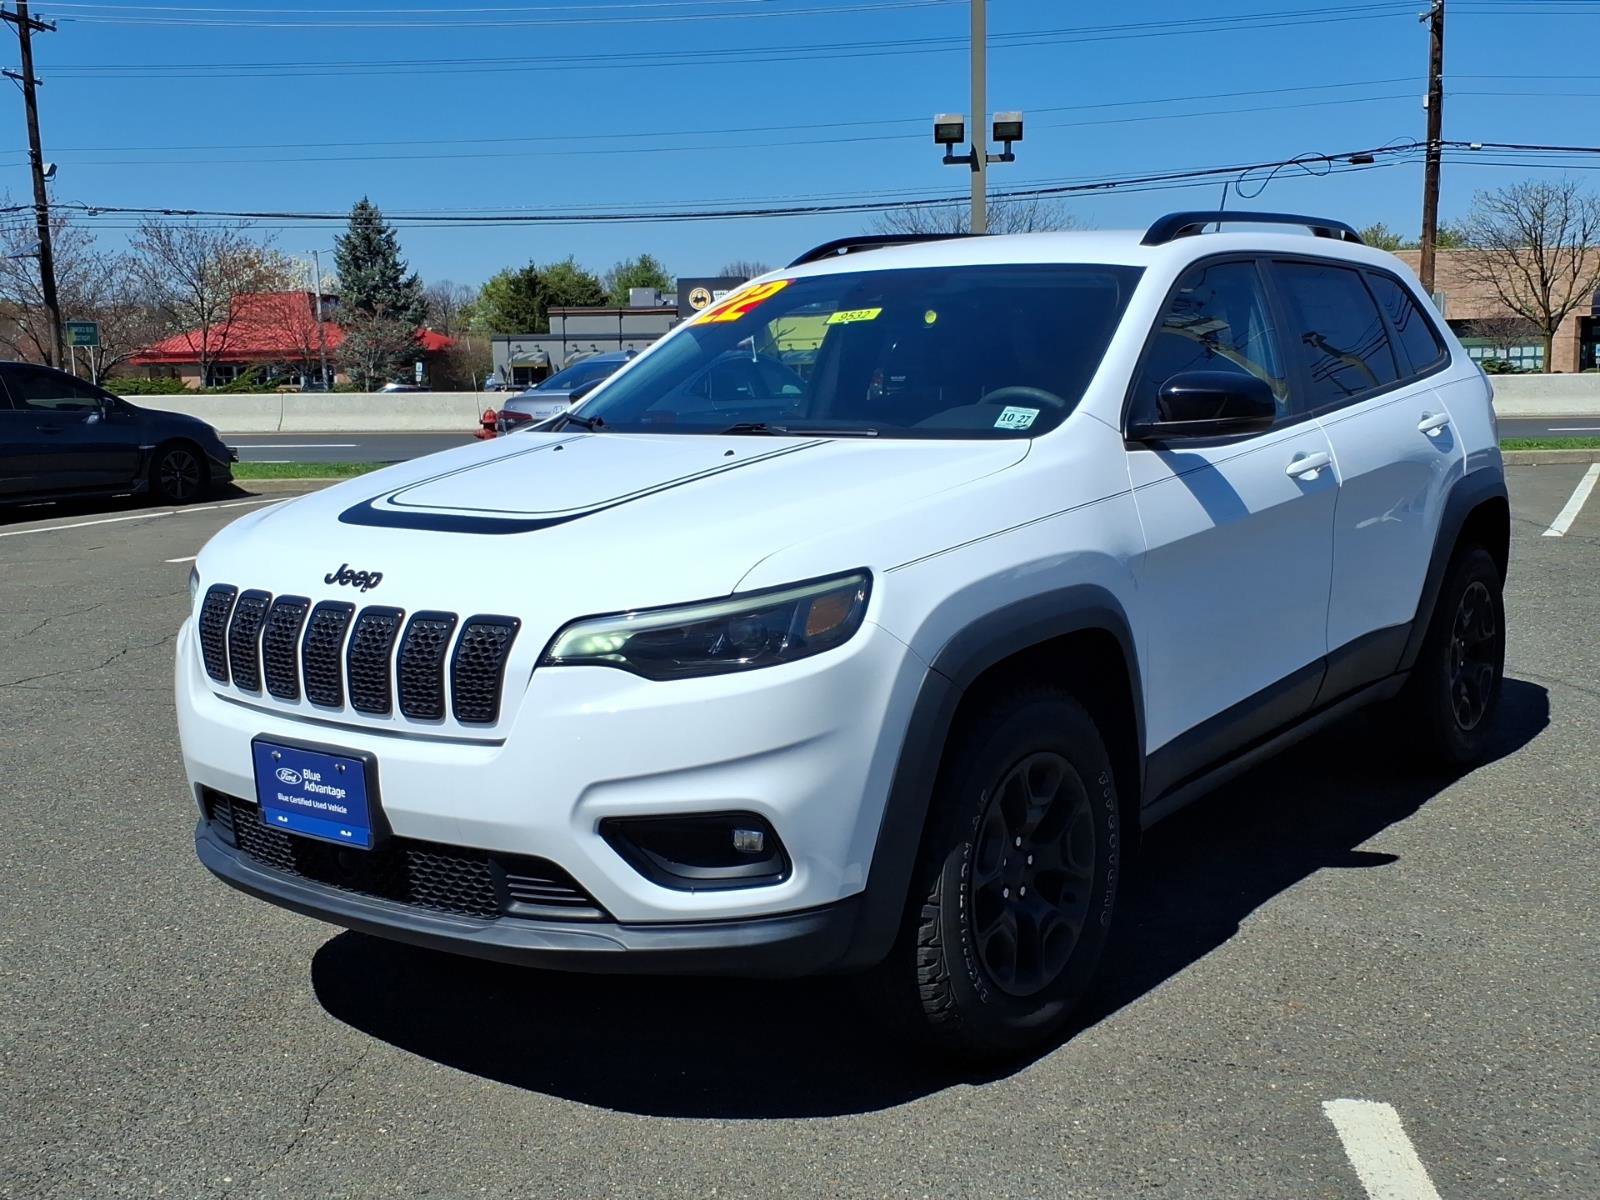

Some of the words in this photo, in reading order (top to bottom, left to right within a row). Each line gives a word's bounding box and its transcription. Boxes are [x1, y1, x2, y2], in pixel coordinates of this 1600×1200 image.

[839, 311, 871, 321] 9532
[1001, 413, 1015, 422] 10
[1017, 415, 1032, 424] 27
[324, 563, 383, 593] Jeep
[281, 769, 297, 782] Ford
[303, 769, 321, 781] Blue
[304, 781, 346, 799] Advantage
[277, 793, 289, 802] Blue
[289, 796, 312, 807] Certified
[312, 801, 327, 810] Used
[327, 803, 348, 814] Vehicle
